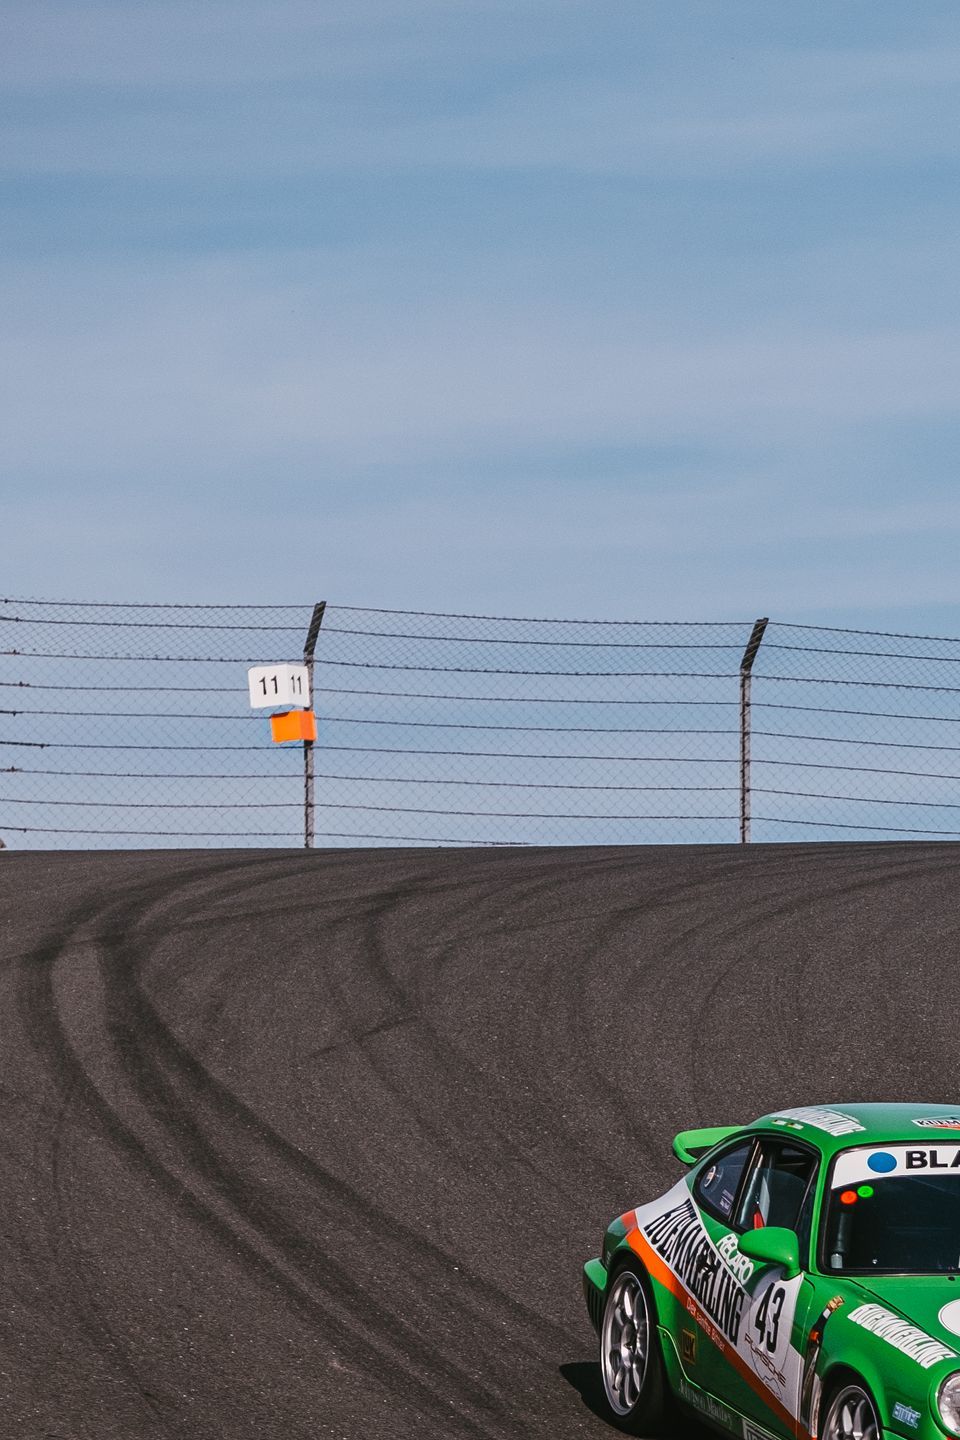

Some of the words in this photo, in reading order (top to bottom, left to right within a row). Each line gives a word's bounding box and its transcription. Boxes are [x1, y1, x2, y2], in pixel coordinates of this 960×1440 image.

[259, 676, 278, 695] 11
[291, 675, 302, 695] 11
[715, 1233, 755, 1286] RECARO
[754, 1281, 786, 1354] 43
